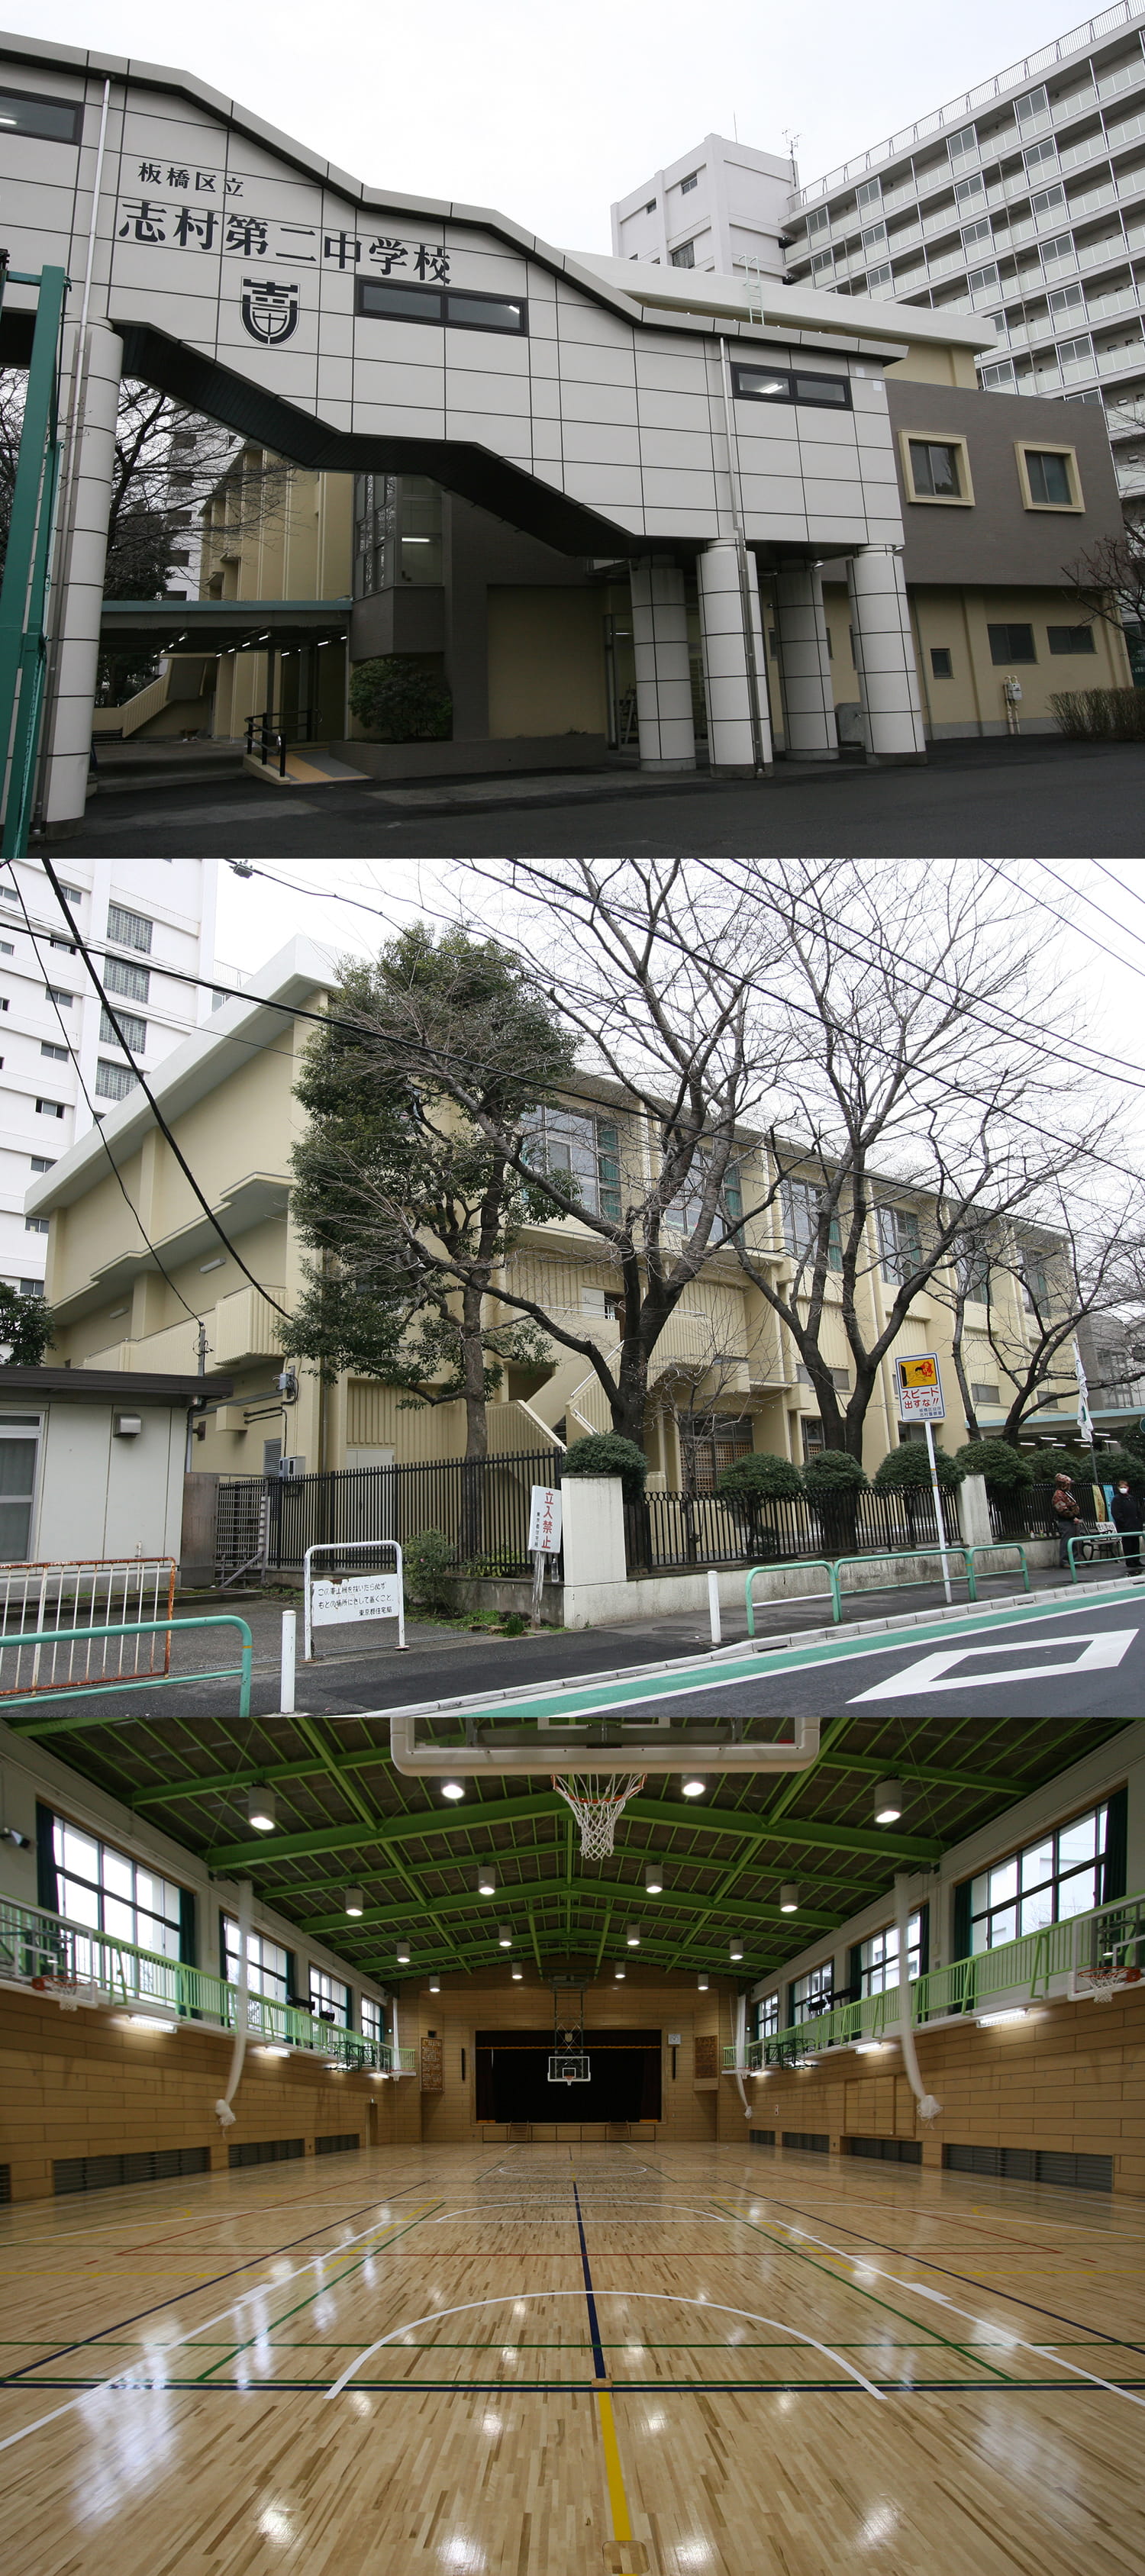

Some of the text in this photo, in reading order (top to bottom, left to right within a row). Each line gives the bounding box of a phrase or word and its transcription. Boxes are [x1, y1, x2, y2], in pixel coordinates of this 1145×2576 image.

[137, 162, 244, 198] 板橋区立
[119, 201, 452, 285] 志村第二中学校
[902, 1388, 939, 1400] スピード
[541, 1491, 554, 1549] 立入禁止
[359, 1606, 392, 1617] 東京都住宅局
